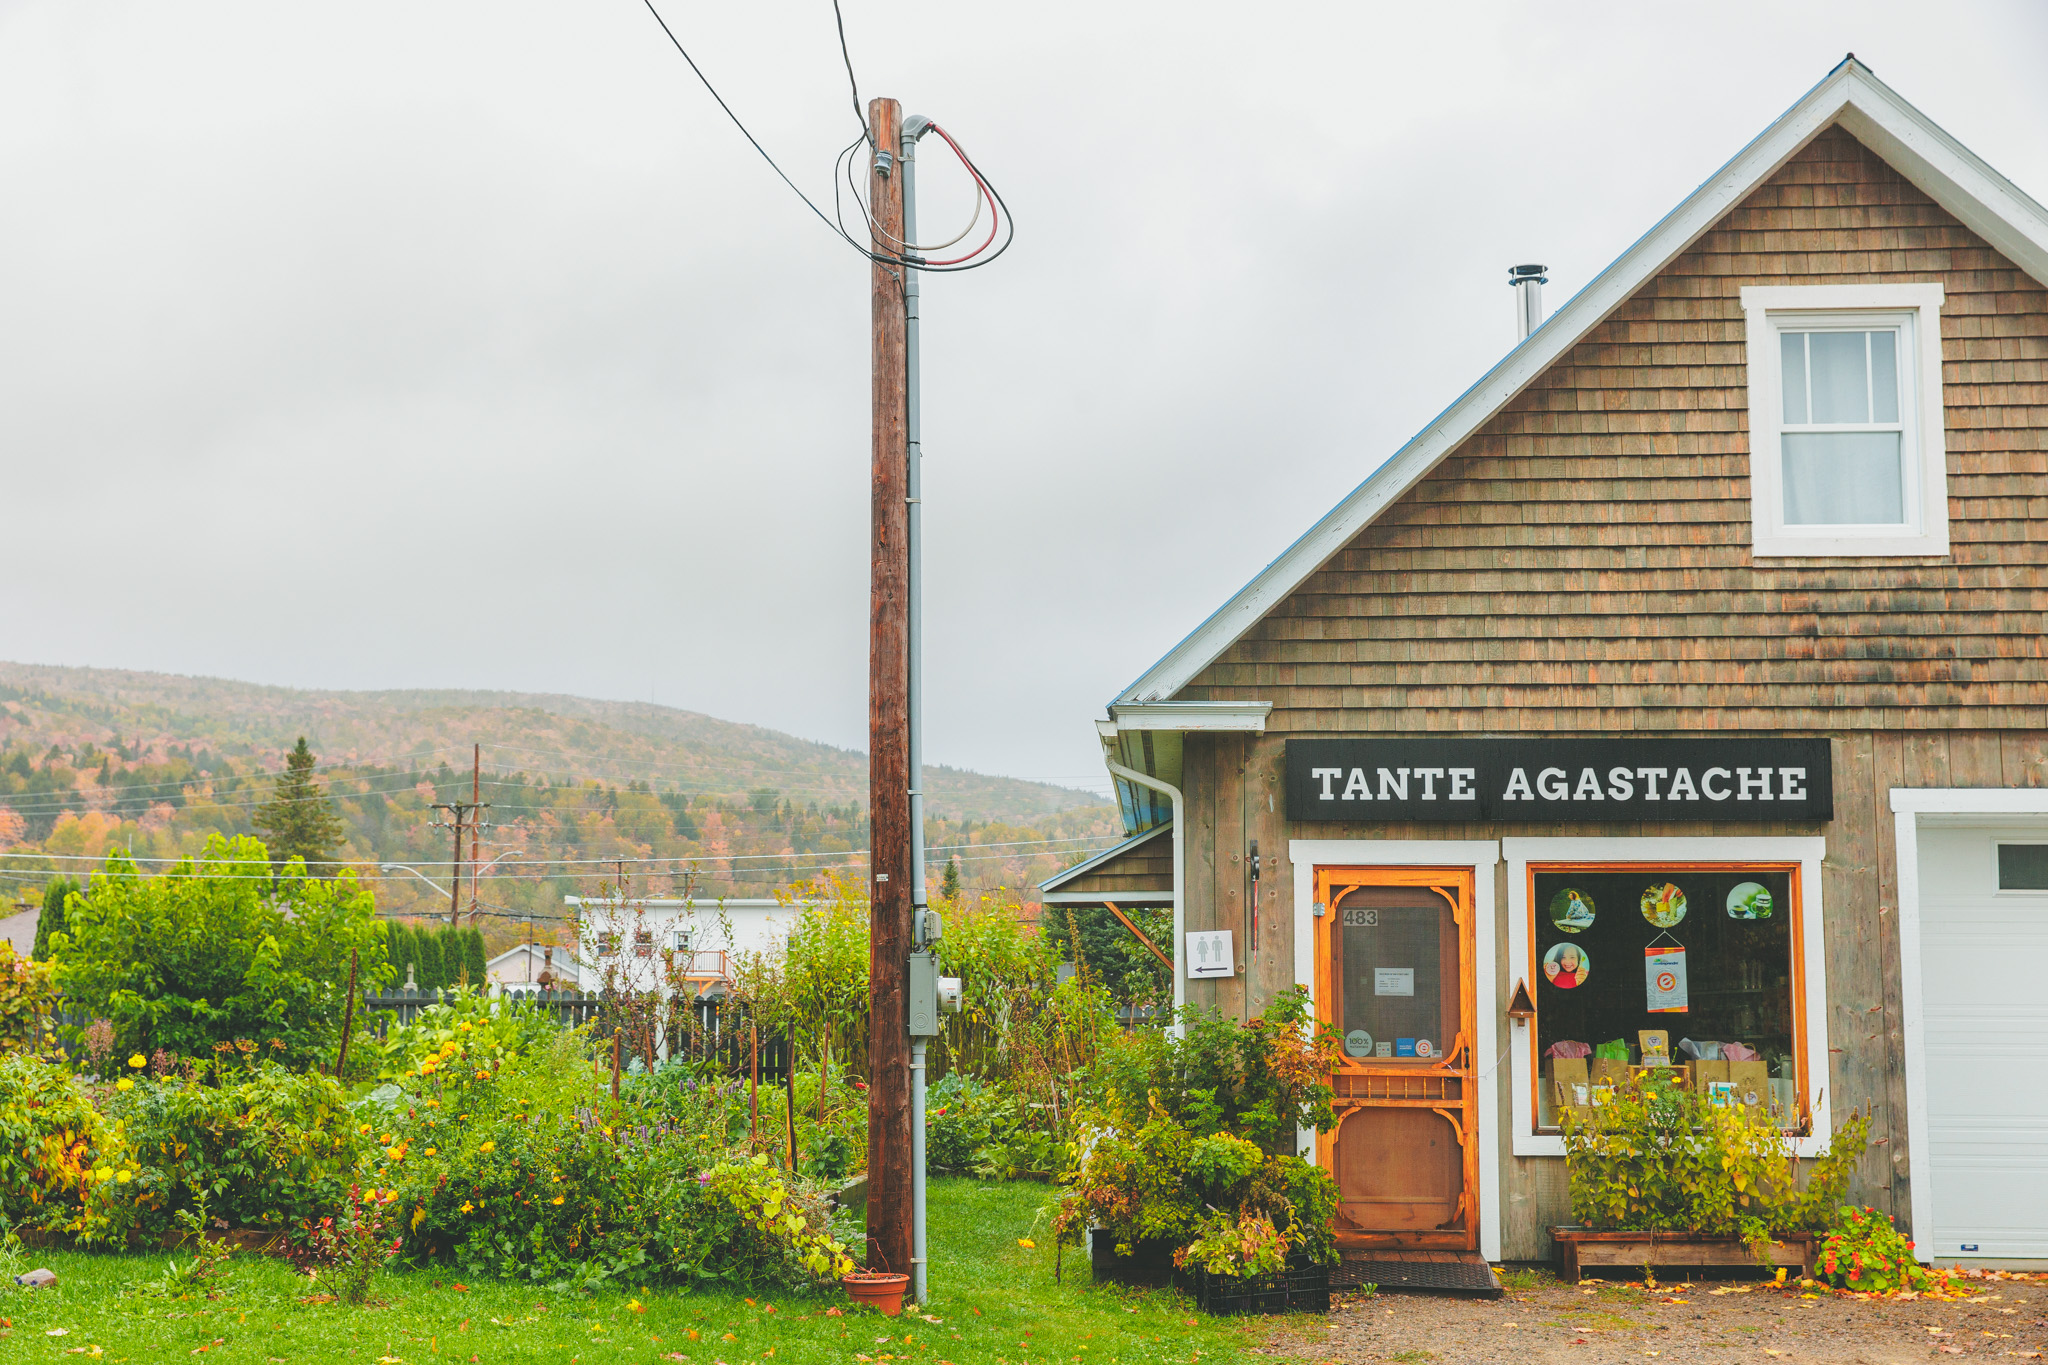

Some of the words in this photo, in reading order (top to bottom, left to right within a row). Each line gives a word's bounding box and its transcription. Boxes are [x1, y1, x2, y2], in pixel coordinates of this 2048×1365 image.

[1312, 767, 1476, 800] TANTE
[1502, 766, 1807, 801] AGASTACHE
[1344, 910, 1377, 925] 483
